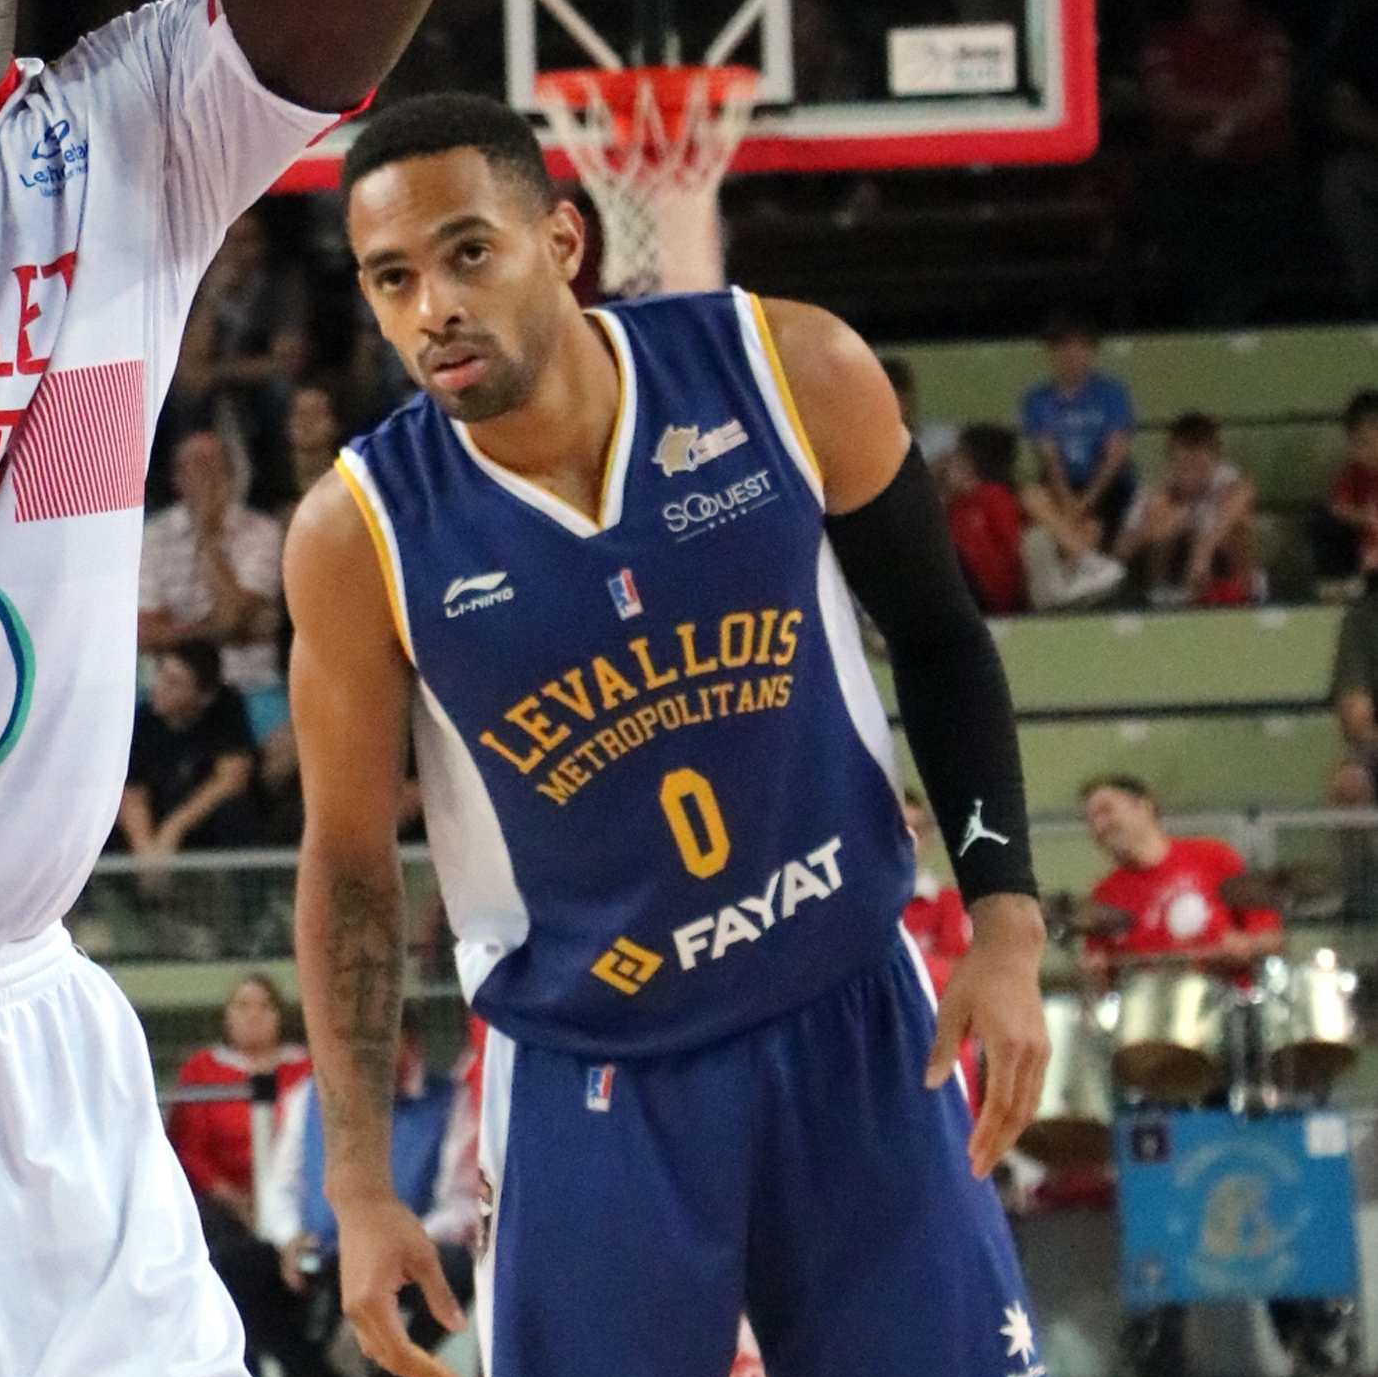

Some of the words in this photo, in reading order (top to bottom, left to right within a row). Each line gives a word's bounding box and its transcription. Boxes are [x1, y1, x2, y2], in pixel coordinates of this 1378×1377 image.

[445, 586, 515, 619] LI-NING
[479, 608, 804, 775] LEVALLOIS
[536, 674, 794, 806] METROPOLITANS
[659, 766, 731, 880] 0
[672, 836, 844, 972] FAYAT
